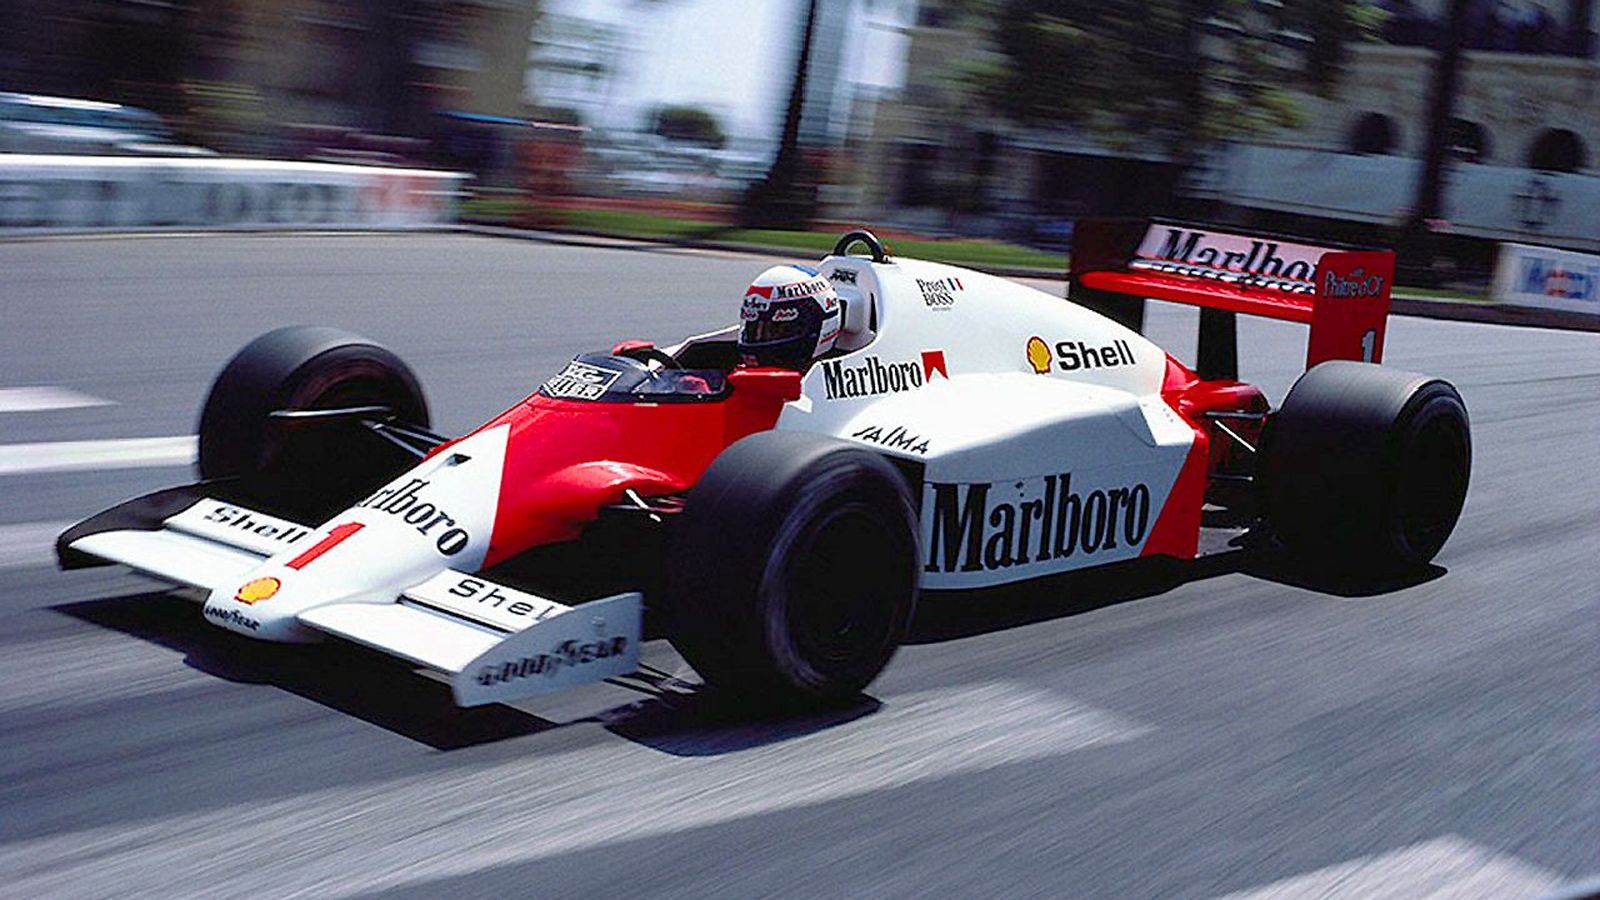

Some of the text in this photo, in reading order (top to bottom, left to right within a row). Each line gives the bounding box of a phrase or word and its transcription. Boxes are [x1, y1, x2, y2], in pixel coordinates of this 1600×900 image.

[1158, 229, 1316, 282] Marlbo
[923, 292, 955, 307] BOSS
[1055, 340, 1136, 371] Shell
[1362, 330, 1377, 363] 1
[821, 356, 923, 400] Marlboro
[204, 507, 307, 544] Shell
[361, 478, 470, 557] rlboro
[924, 472, 1150, 573] Marlboro
[285, 521, 366, 571] 1
[448, 579, 555, 621] Shel
